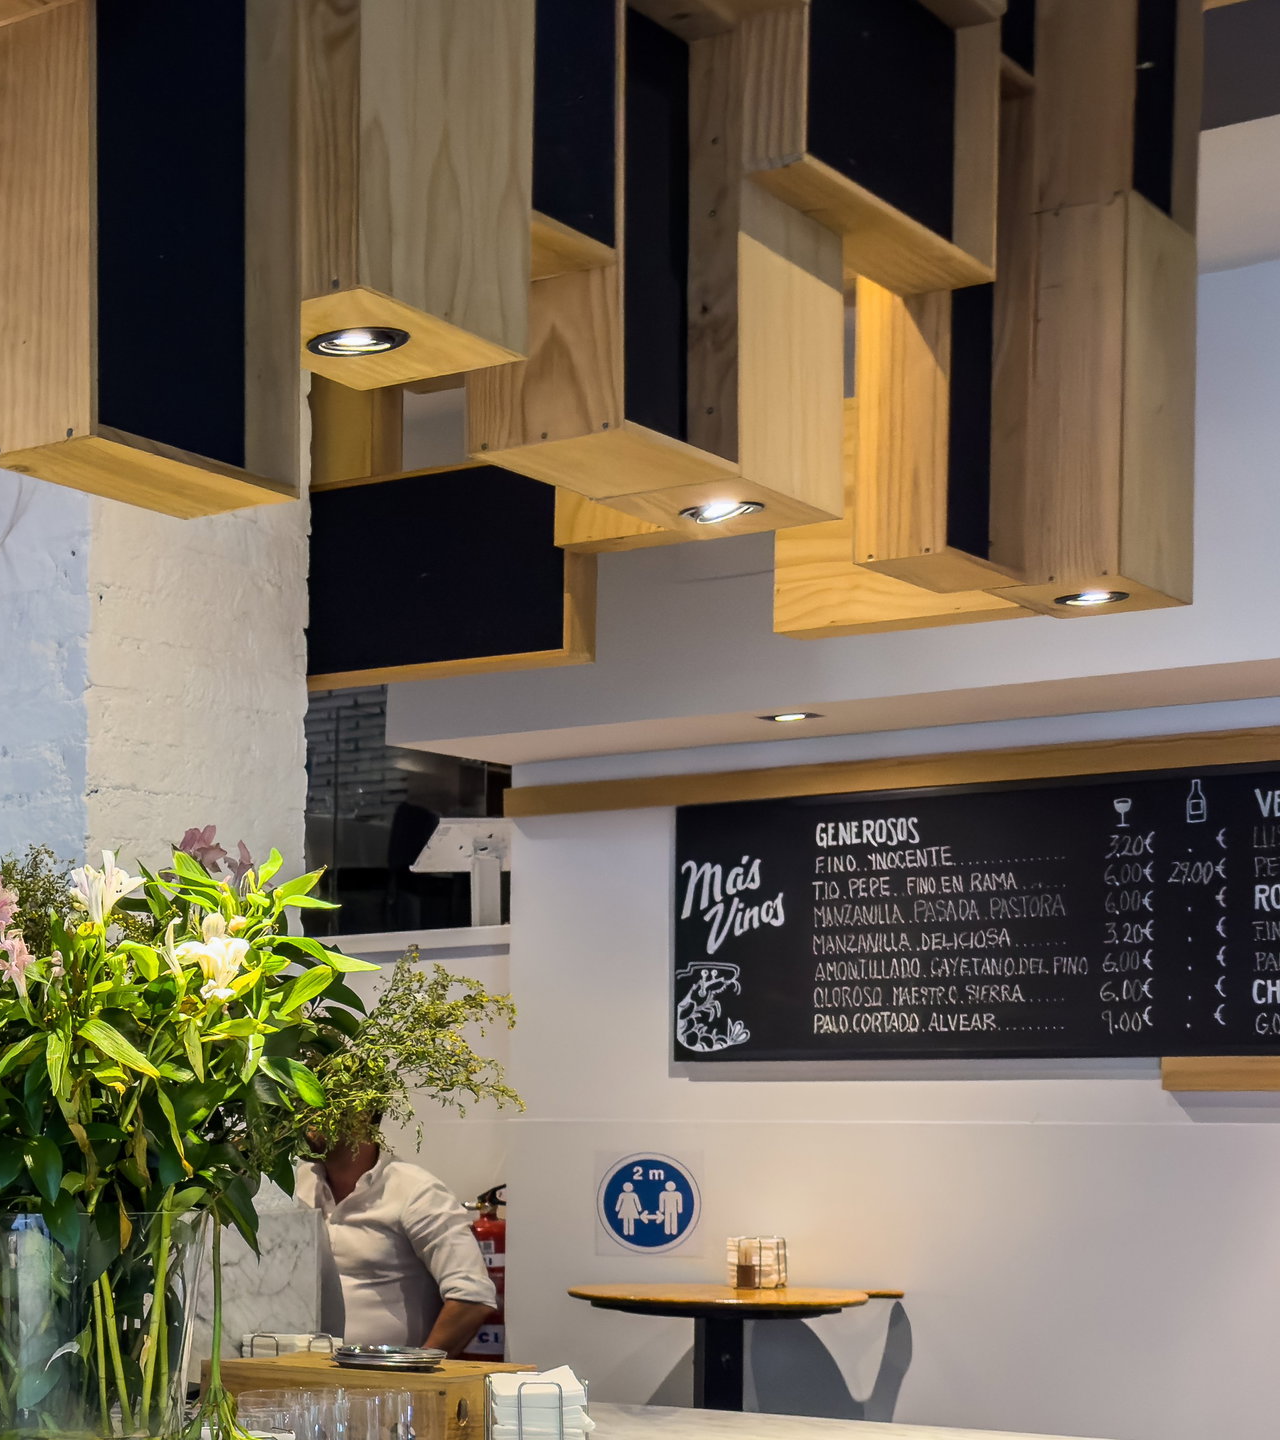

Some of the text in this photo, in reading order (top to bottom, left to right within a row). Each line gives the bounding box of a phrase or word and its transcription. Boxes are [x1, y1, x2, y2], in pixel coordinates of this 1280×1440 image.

[816, 817, 920, 849] GENEROSOS
[681, 855, 762, 919] Más
[907, 877, 936, 896] FINO
[970, 872, 1018, 892] RAMA
[990, 894, 1066, 919] PASTORA
[704, 892, 785, 955] Vinos
[812, 928, 1011, 955] MANZANILLA DELICIOSA
[1053, 956, 1089, 976] PINO
[852, 1012, 920, 1033] CORTADO
[928, 1012, 997, 1031] ALVEAR
[632, 1166, 665, 1181] 2 m
